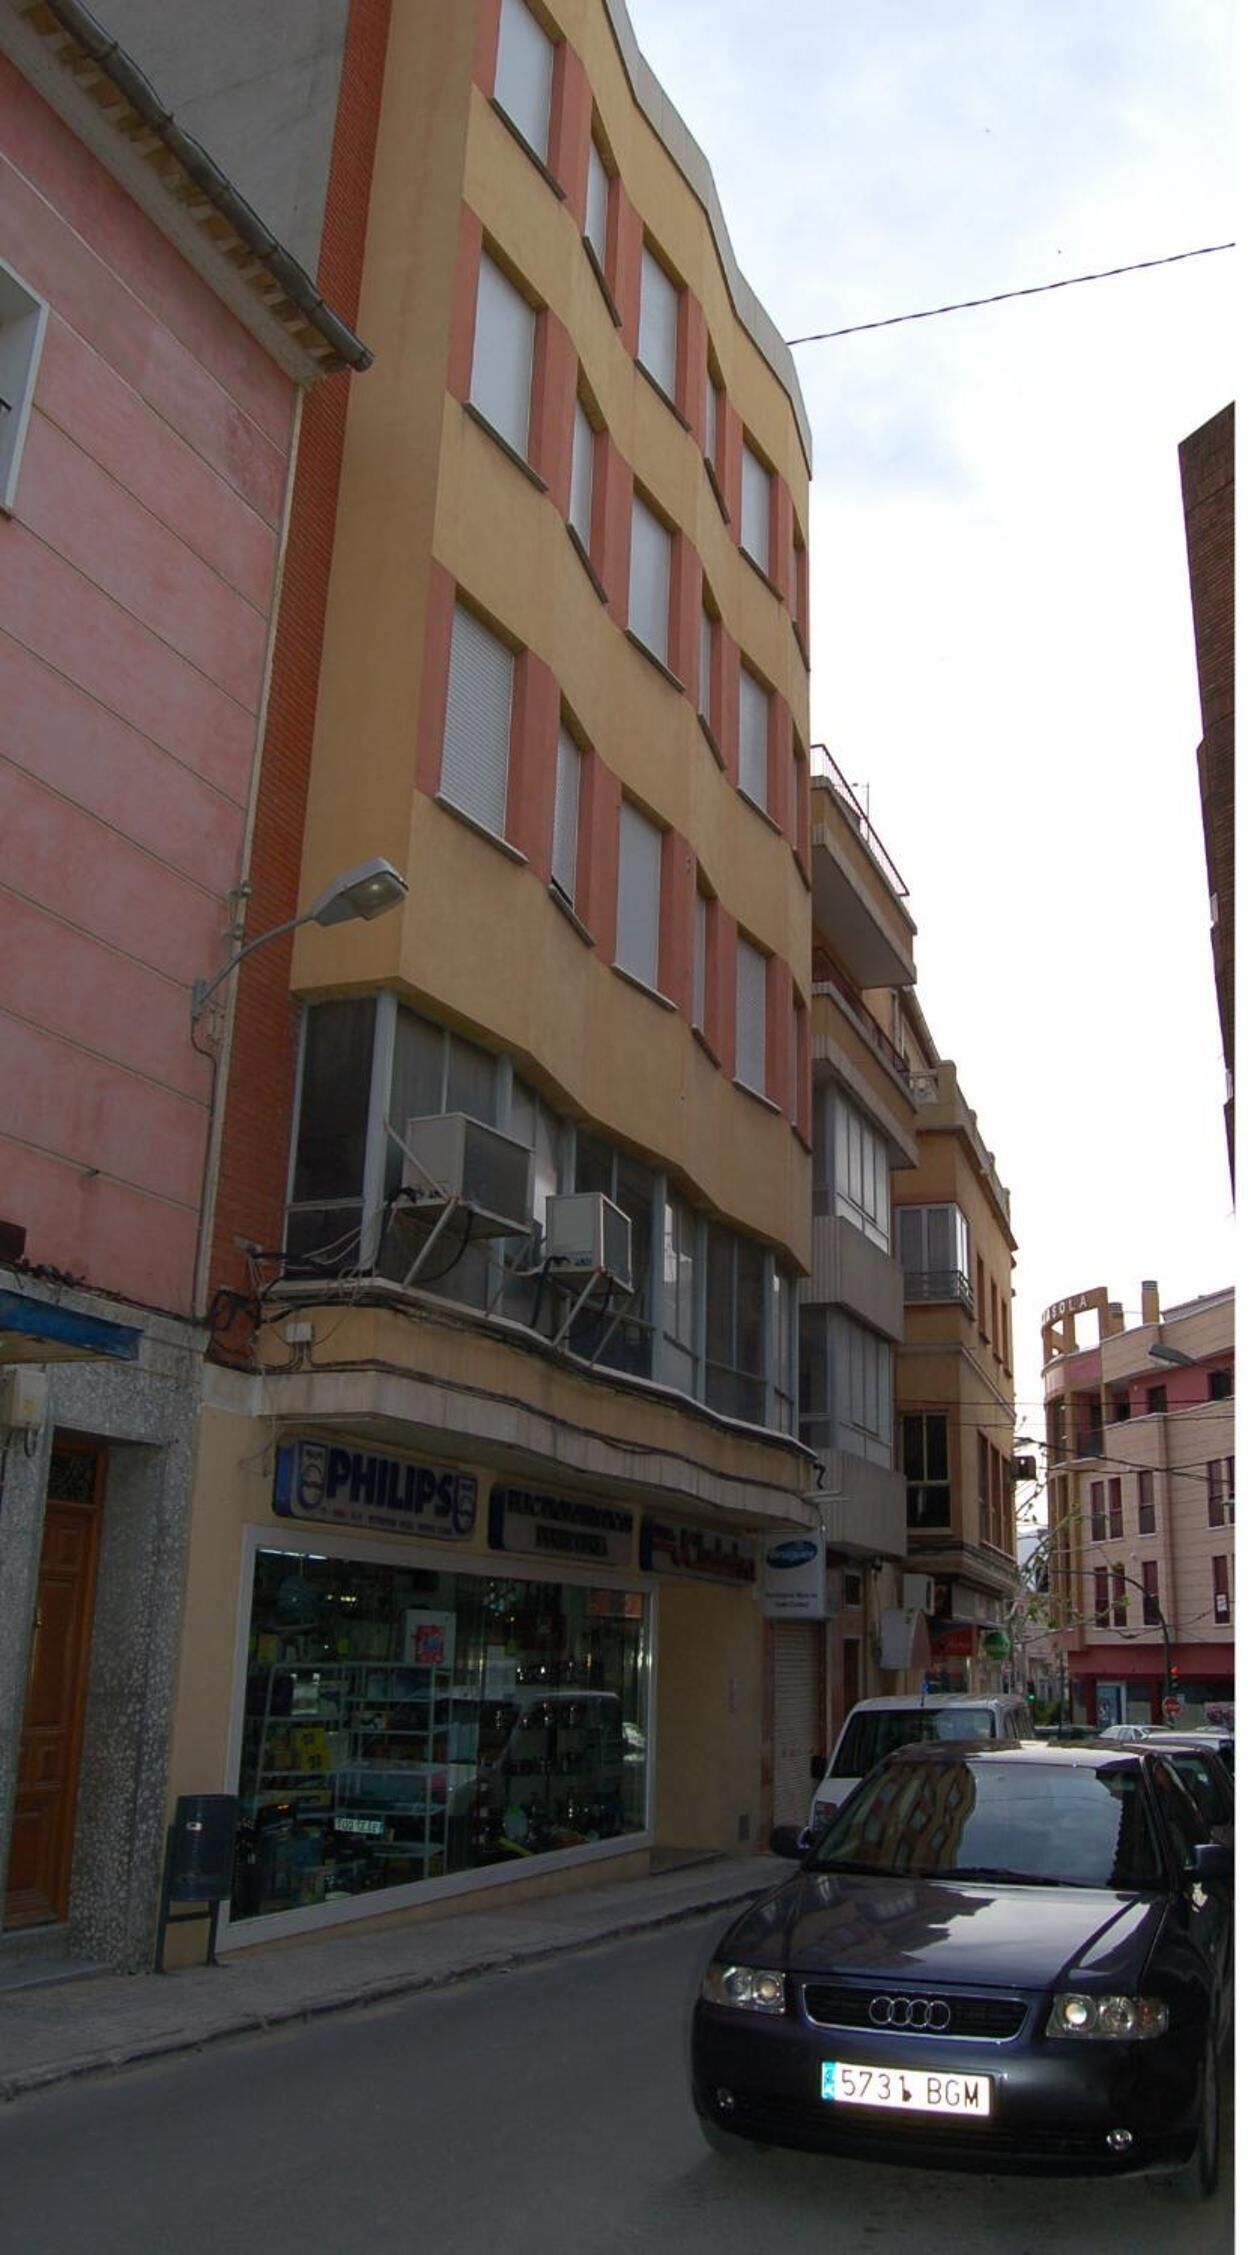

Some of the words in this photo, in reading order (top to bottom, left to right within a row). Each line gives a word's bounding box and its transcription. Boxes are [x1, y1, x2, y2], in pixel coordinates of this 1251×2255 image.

[326, 1446, 453, 1517] PHILIPS
[841, 2069, 911, 2102] 5731
[927, 2076, 979, 2109] BGM
